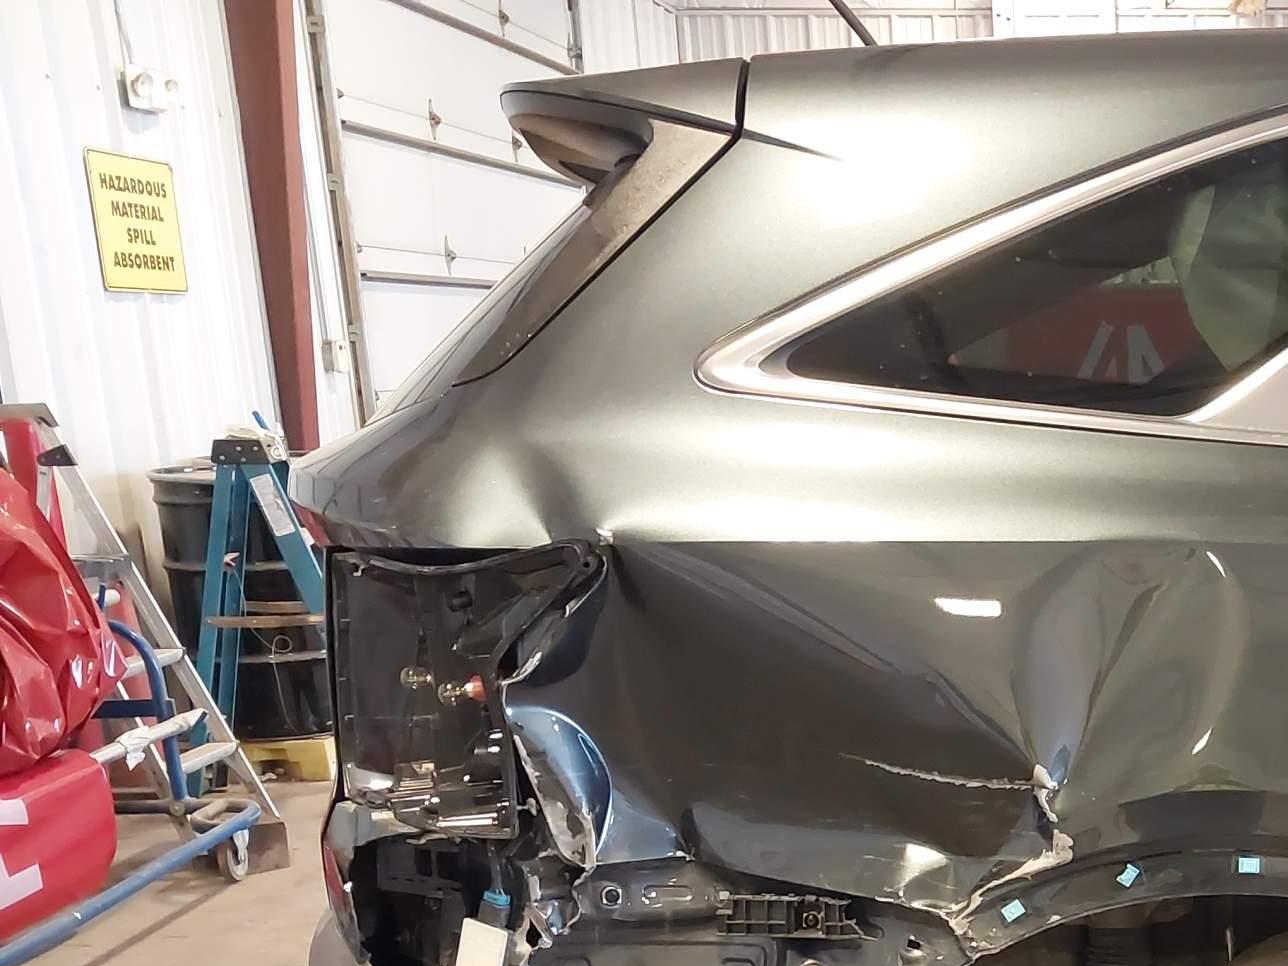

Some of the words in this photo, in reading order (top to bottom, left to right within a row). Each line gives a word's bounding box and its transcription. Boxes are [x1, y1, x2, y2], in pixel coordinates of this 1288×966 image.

[99, 172, 167, 198] HAZARDOUS
[111, 200, 164, 222] MATERIAL
[127, 227, 156, 245] SPILL
[113, 251, 175, 272] ABSORBENT
